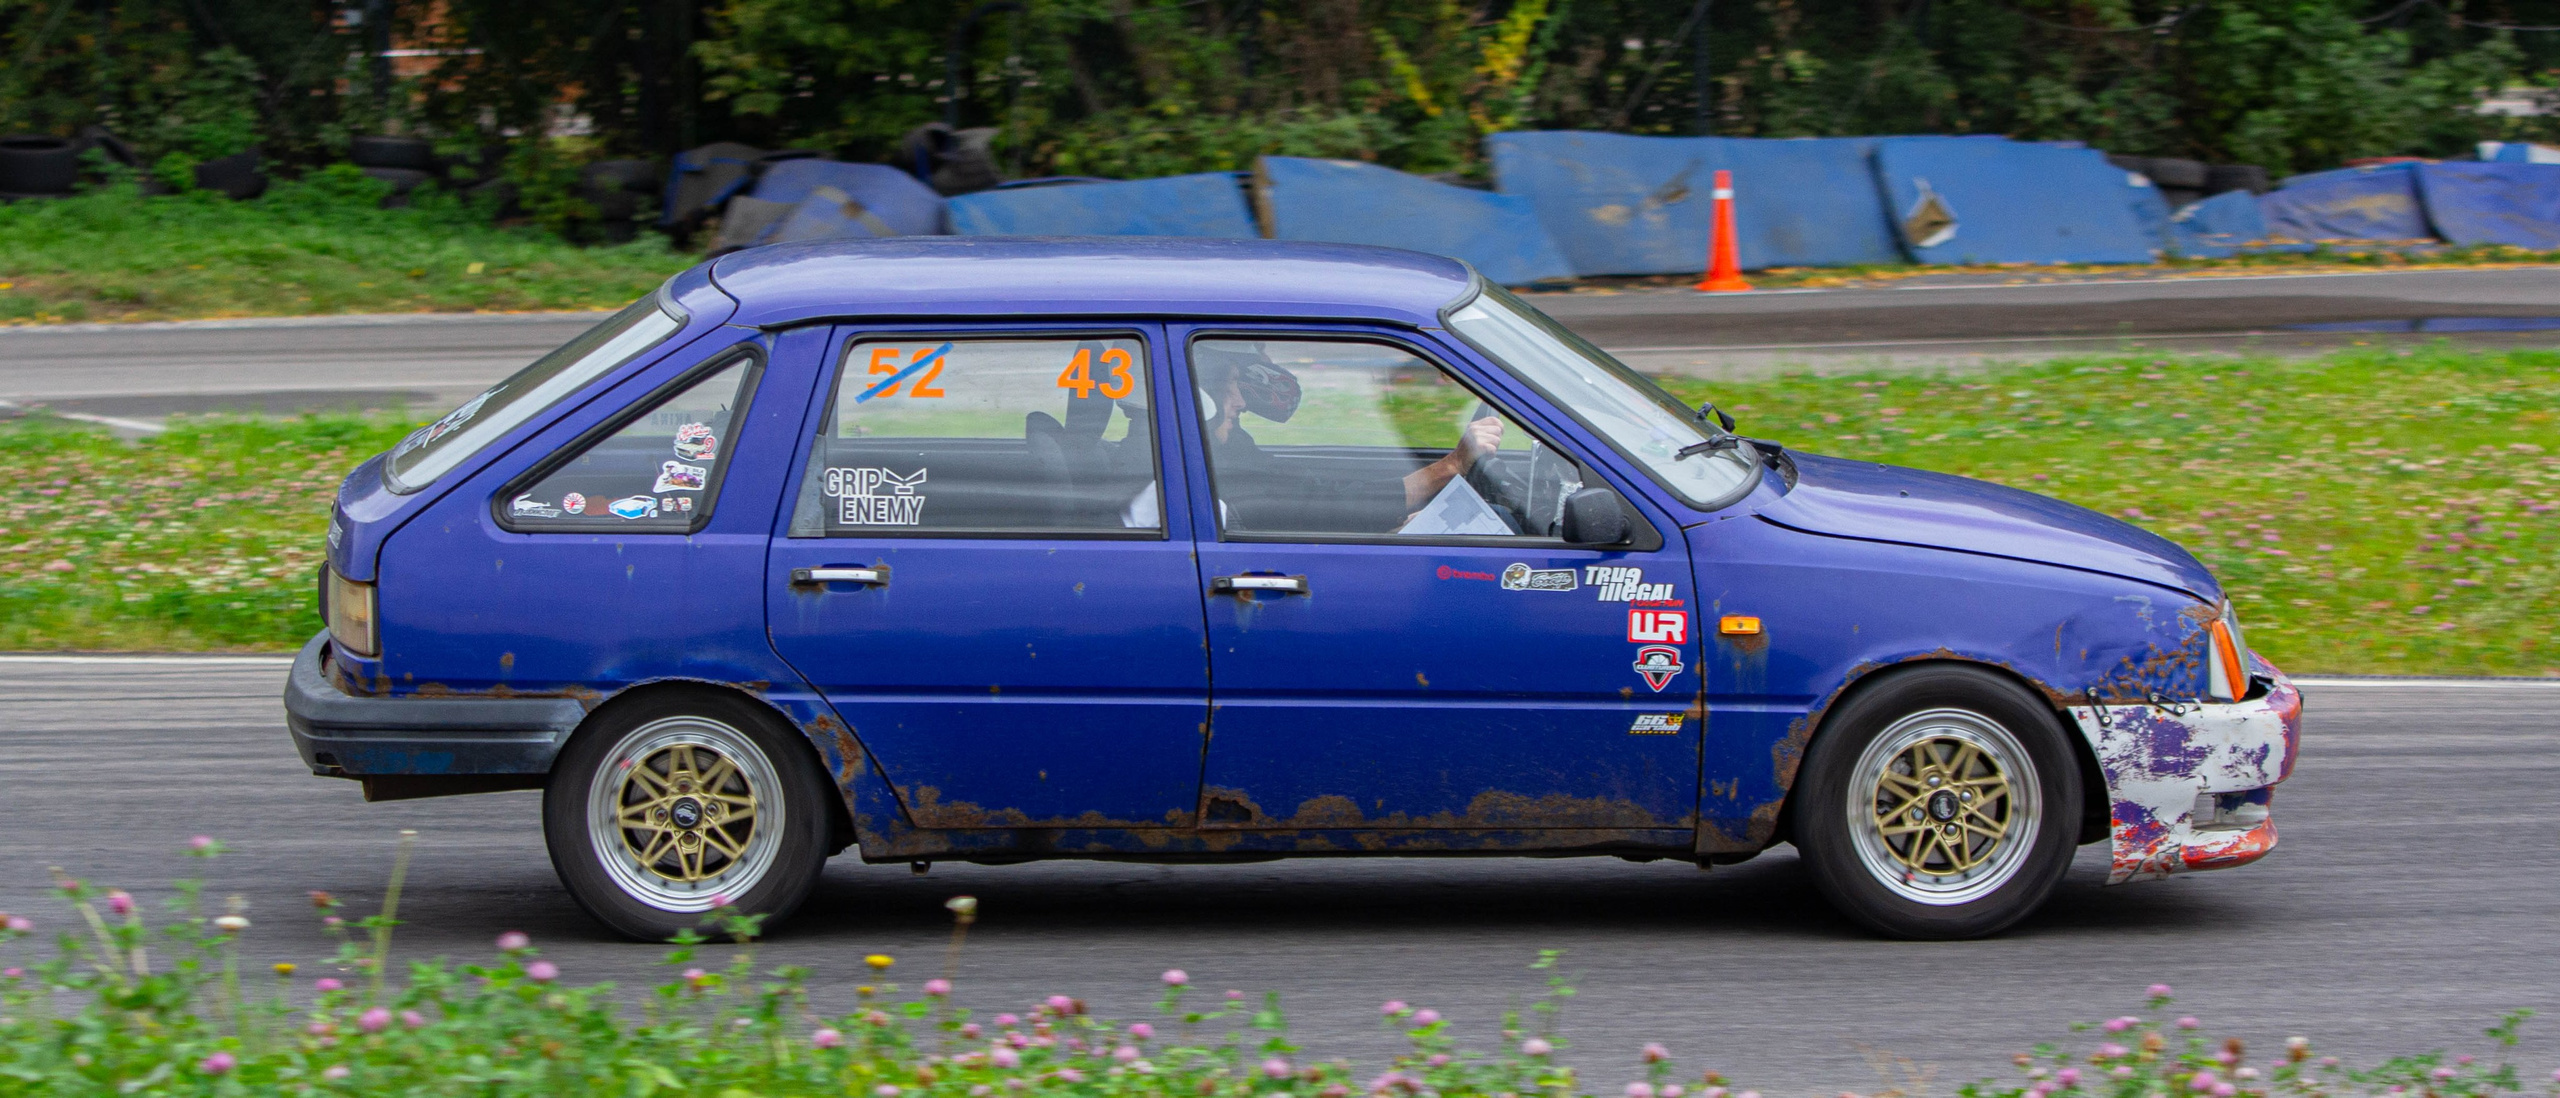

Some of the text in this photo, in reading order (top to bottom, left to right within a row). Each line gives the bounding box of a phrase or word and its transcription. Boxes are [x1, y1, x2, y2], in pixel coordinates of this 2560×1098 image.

[1057, 348, 1134, 399] 43
[824, 468, 883, 497] GRIP
[839, 496, 926, 525] ENEMY
[1631, 612, 1684, 641] WR
[1636, 714, 1669, 724] 66
